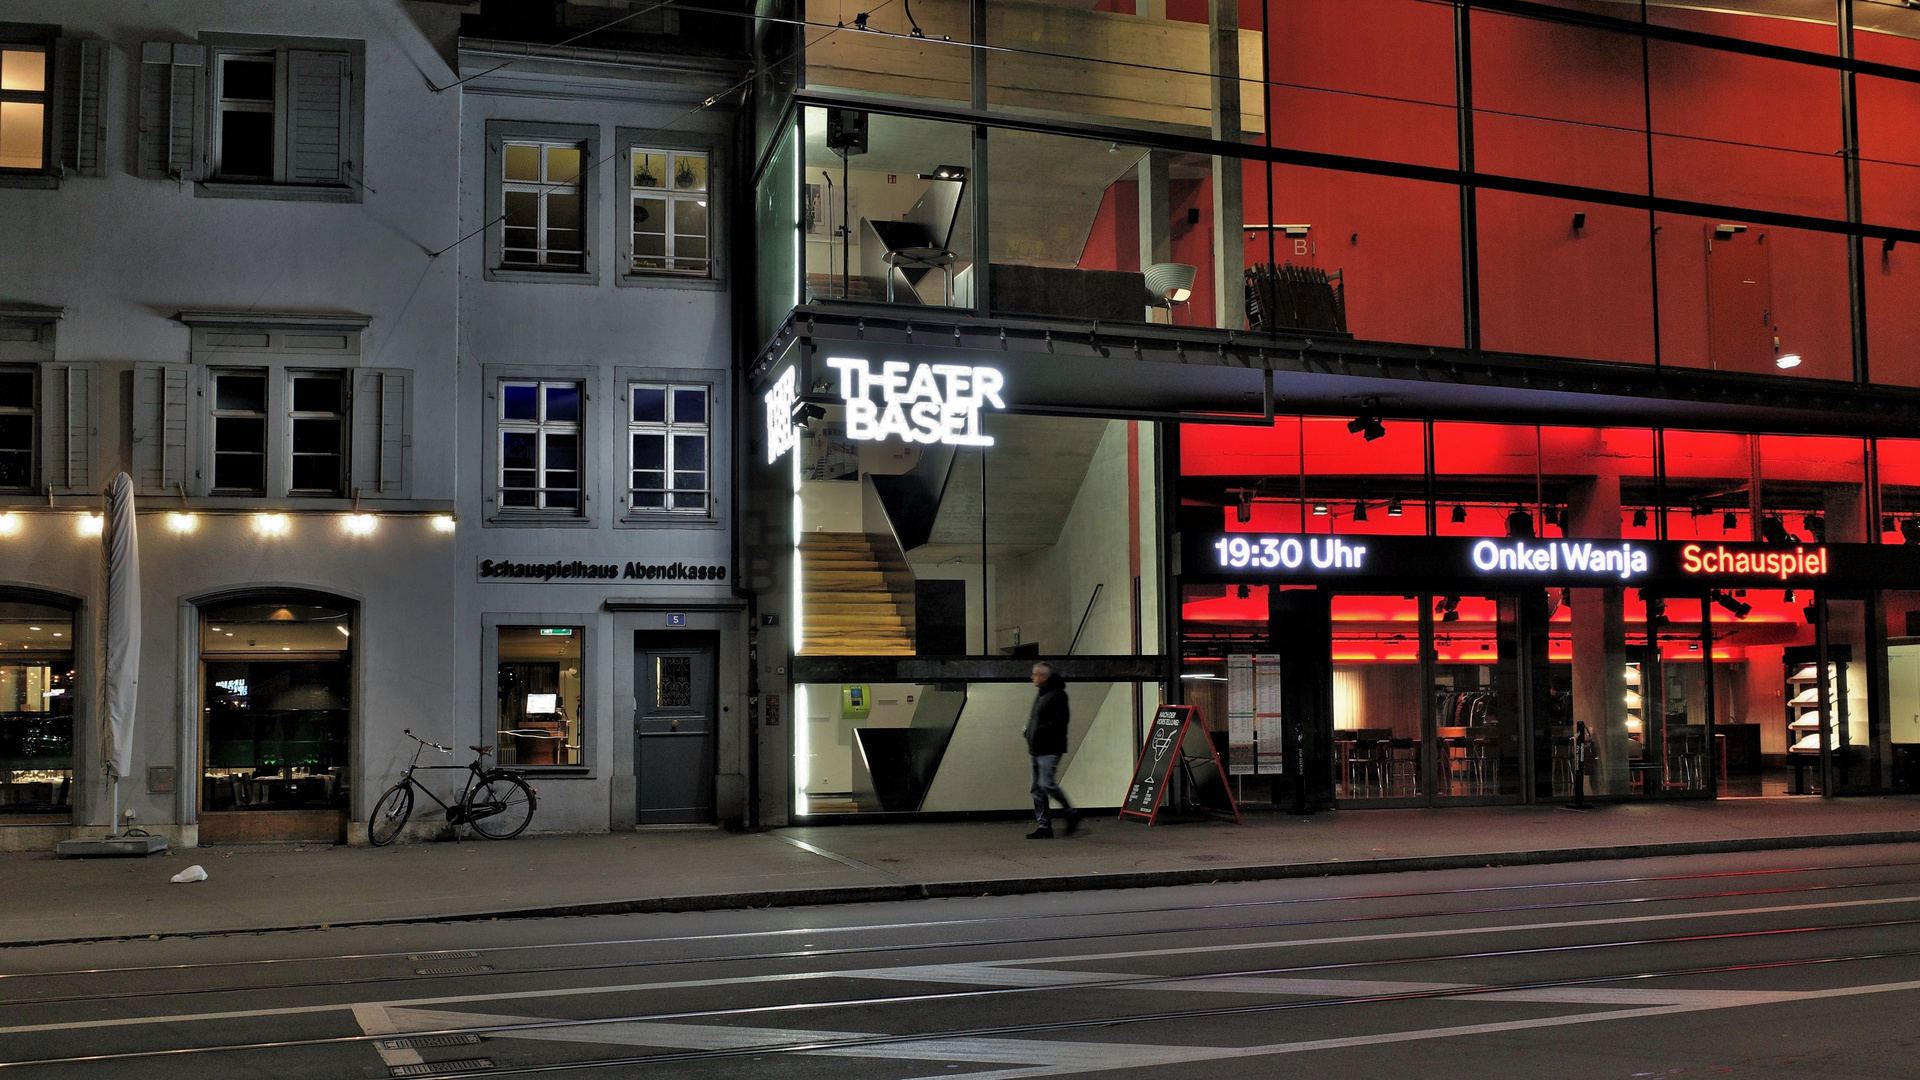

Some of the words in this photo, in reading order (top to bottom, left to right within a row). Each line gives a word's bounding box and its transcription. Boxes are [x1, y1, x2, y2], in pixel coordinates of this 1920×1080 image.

[1294, 239, 1308, 256] B
[826, 356, 1006, 409] THEATER
[845, 398, 995, 447] BASEL
[1215, 537, 1303, 569] 19:30
[1309, 538, 1367, 569] Uhr
[1473, 540, 1557, 572] Onkel
[1561, 543, 1648, 579] Wanja
[1683, 545, 1827, 579] Schauspiel
[480, 559, 619, 581] Schauspielhaus
[622, 561, 727, 580] Abendkasse
[673, 615, 679, 624] 5
[767, 616, 774, 625] 7
